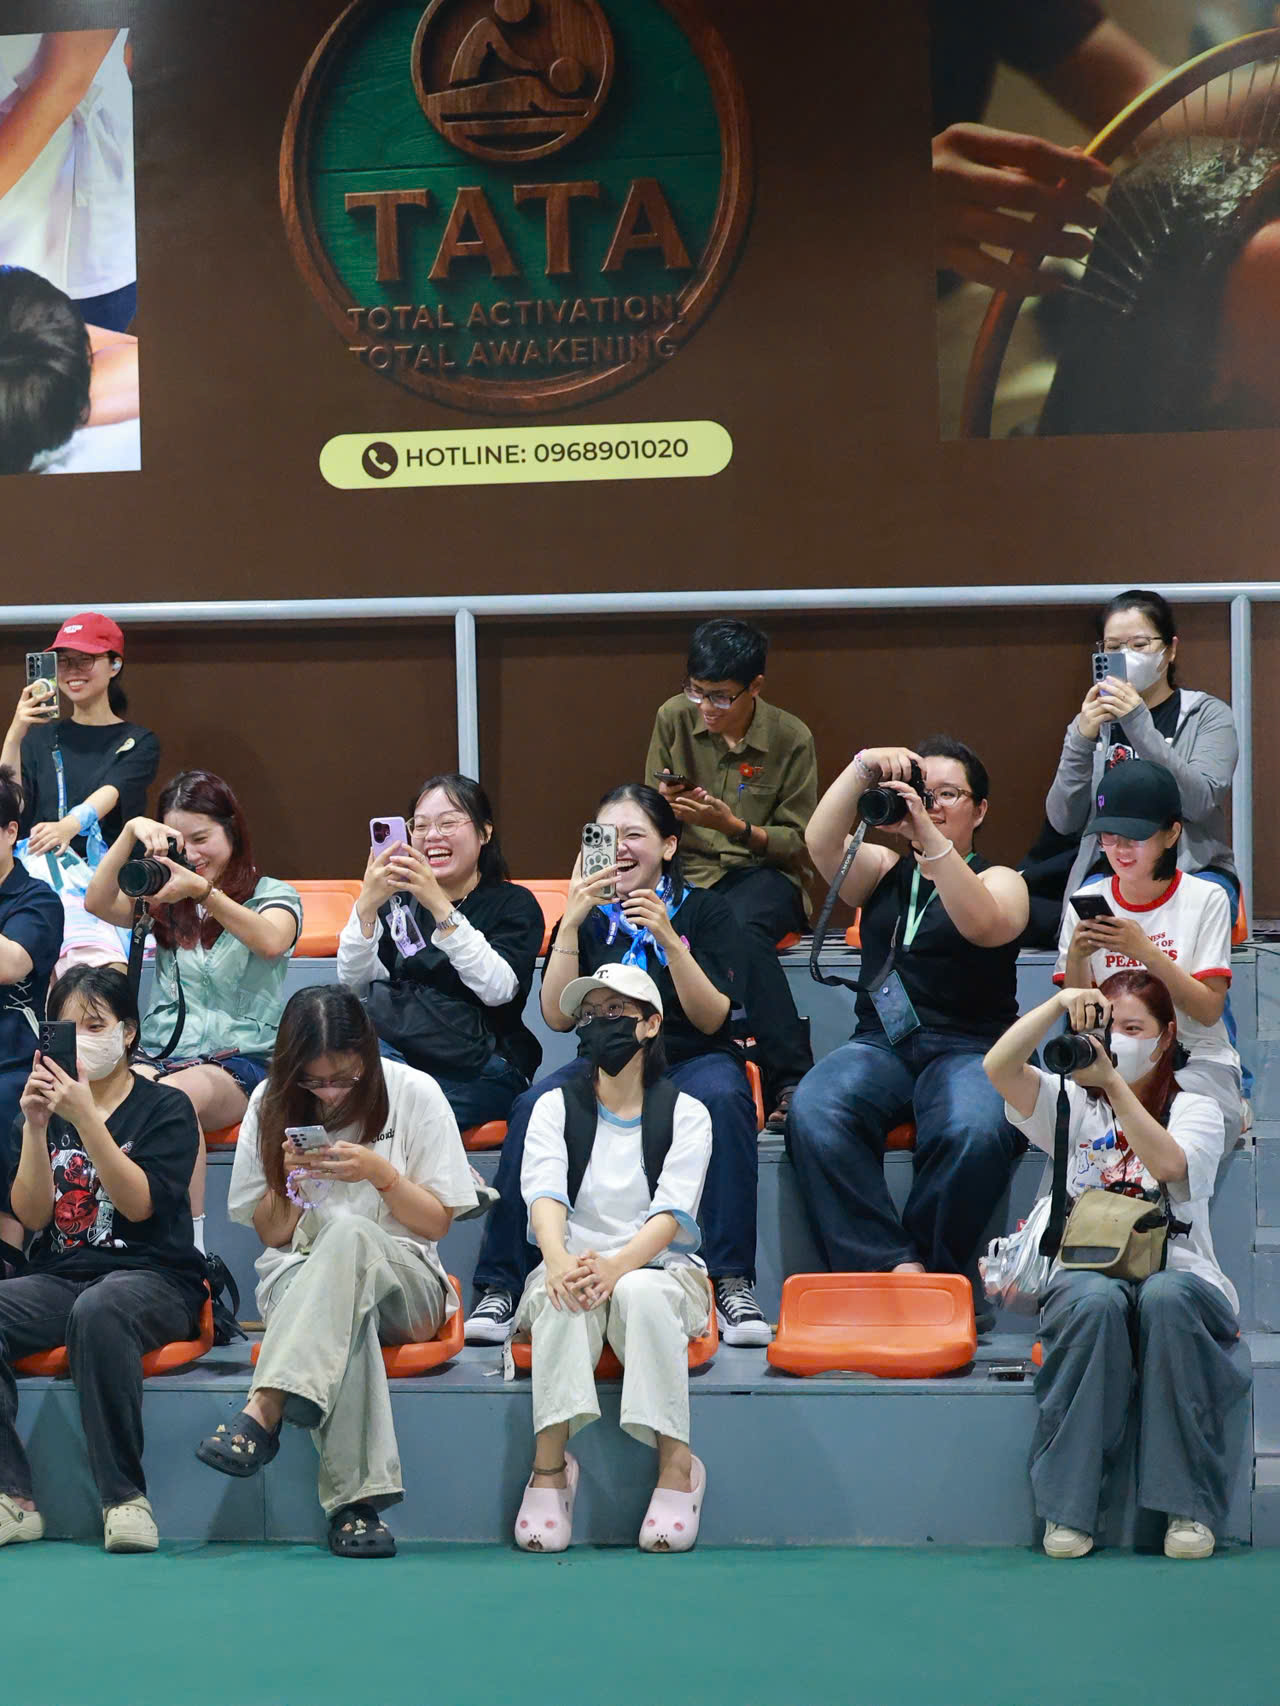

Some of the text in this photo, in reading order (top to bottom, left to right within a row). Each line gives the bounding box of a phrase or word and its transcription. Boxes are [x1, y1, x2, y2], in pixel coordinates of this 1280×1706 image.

[344, 178, 692, 283] TATA
[347, 303, 454, 332] TOTAL
[348, 335, 677, 369] TOTAL AWAKENING
[406, 438, 689, 467] HOTLINE: 0968901020
